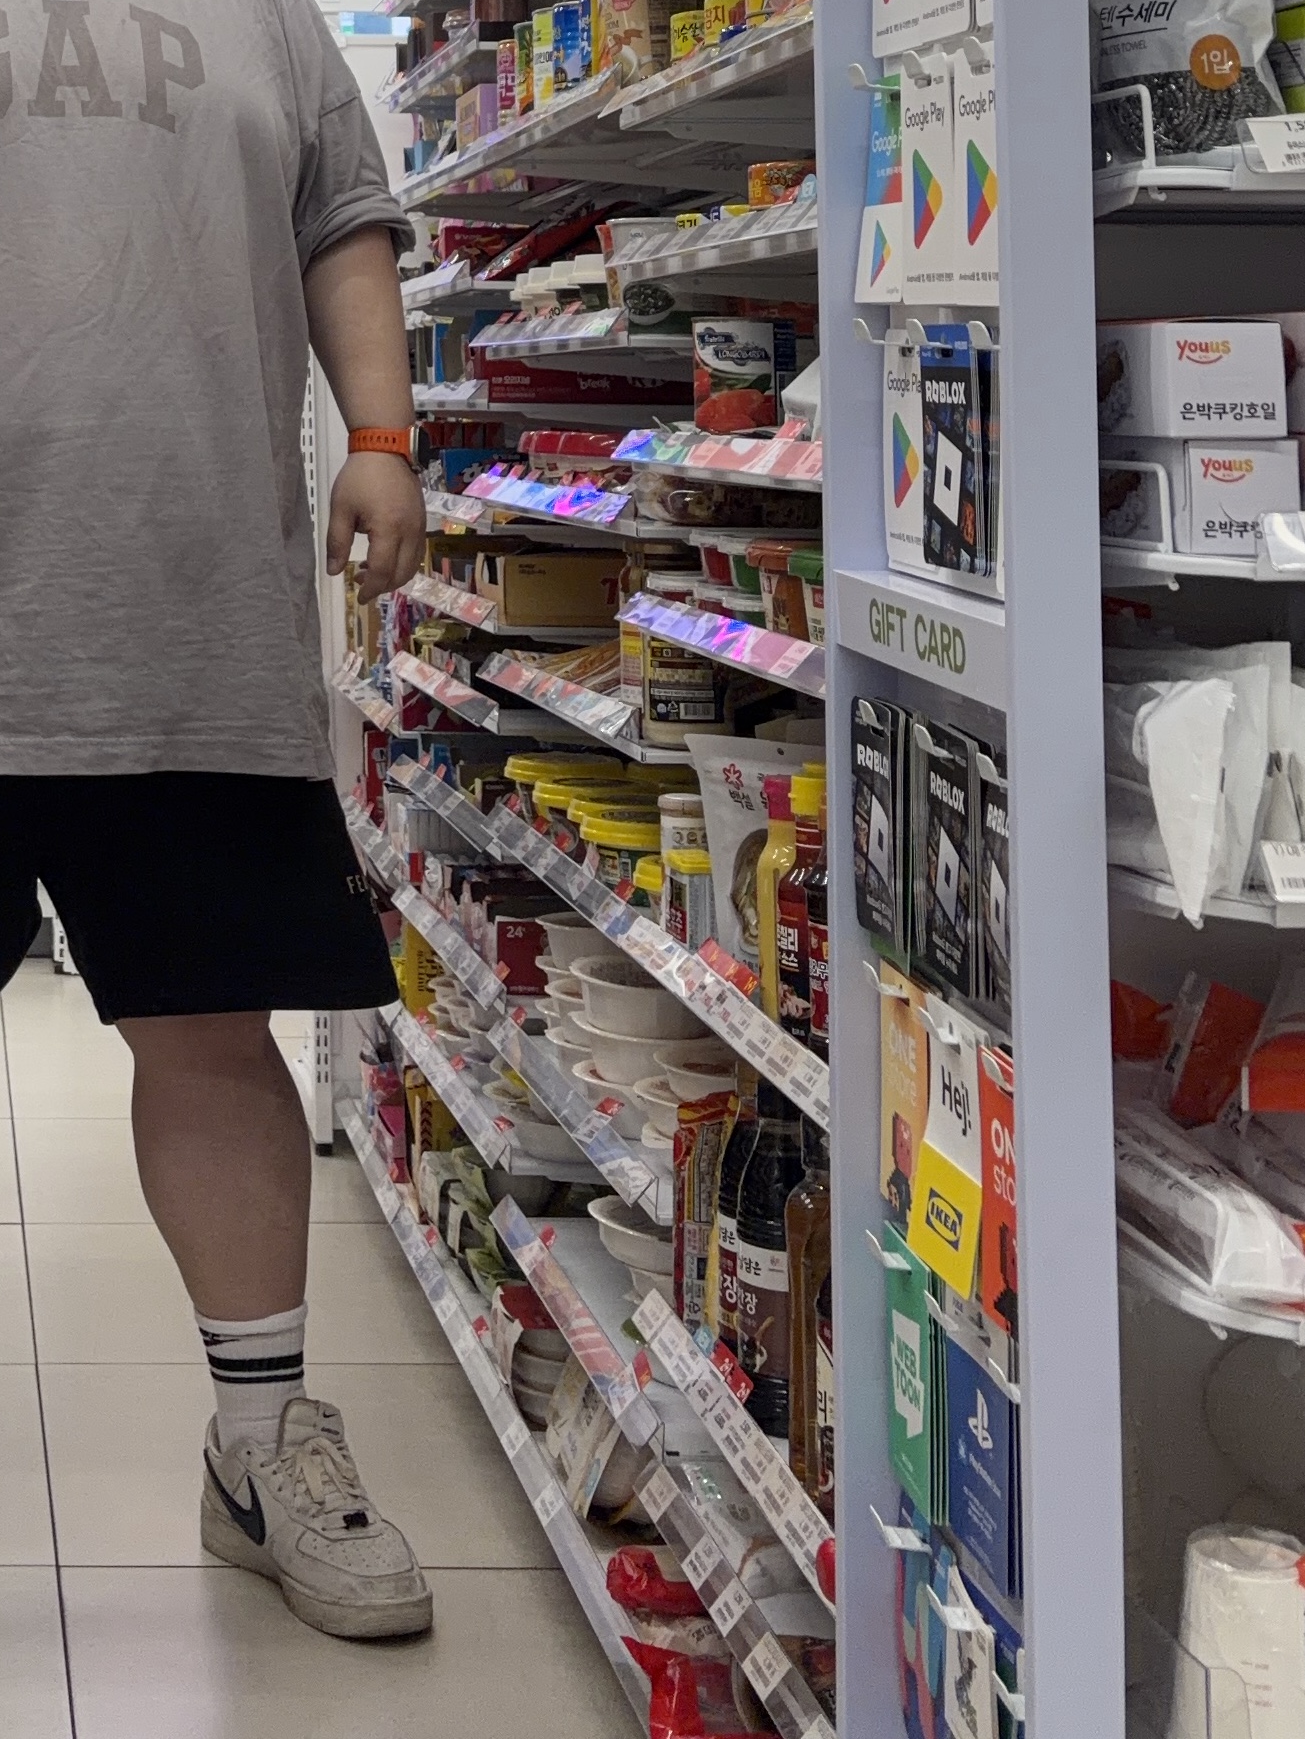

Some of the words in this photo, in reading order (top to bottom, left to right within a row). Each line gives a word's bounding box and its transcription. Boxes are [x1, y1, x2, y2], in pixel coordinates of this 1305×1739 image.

[1201, 48, 1230, 74] 1입
[904, 105, 930, 131] Google
[930, 101, 945, 127] Play
[959, 91, 987, 120] Google
[1176, 339, 1231, 361] youus
[886, 369, 911, 398] Google
[925, 380, 966, 405] ROBLOX
[1180, 401, 1277, 422] 은박쿠킹호일
[1200, 458, 1254, 479] youus
[869, 597, 907, 652] GIFT
[914, 613, 967, 675] CARD
[930, 770, 966, 816] ROBLOX
[941, 1064, 972, 1138] Hej!
[930, 1200, 959, 1238] IKEA
[895, 1334, 917, 1380] WEB
[895, 1358, 921, 1412] TOON
